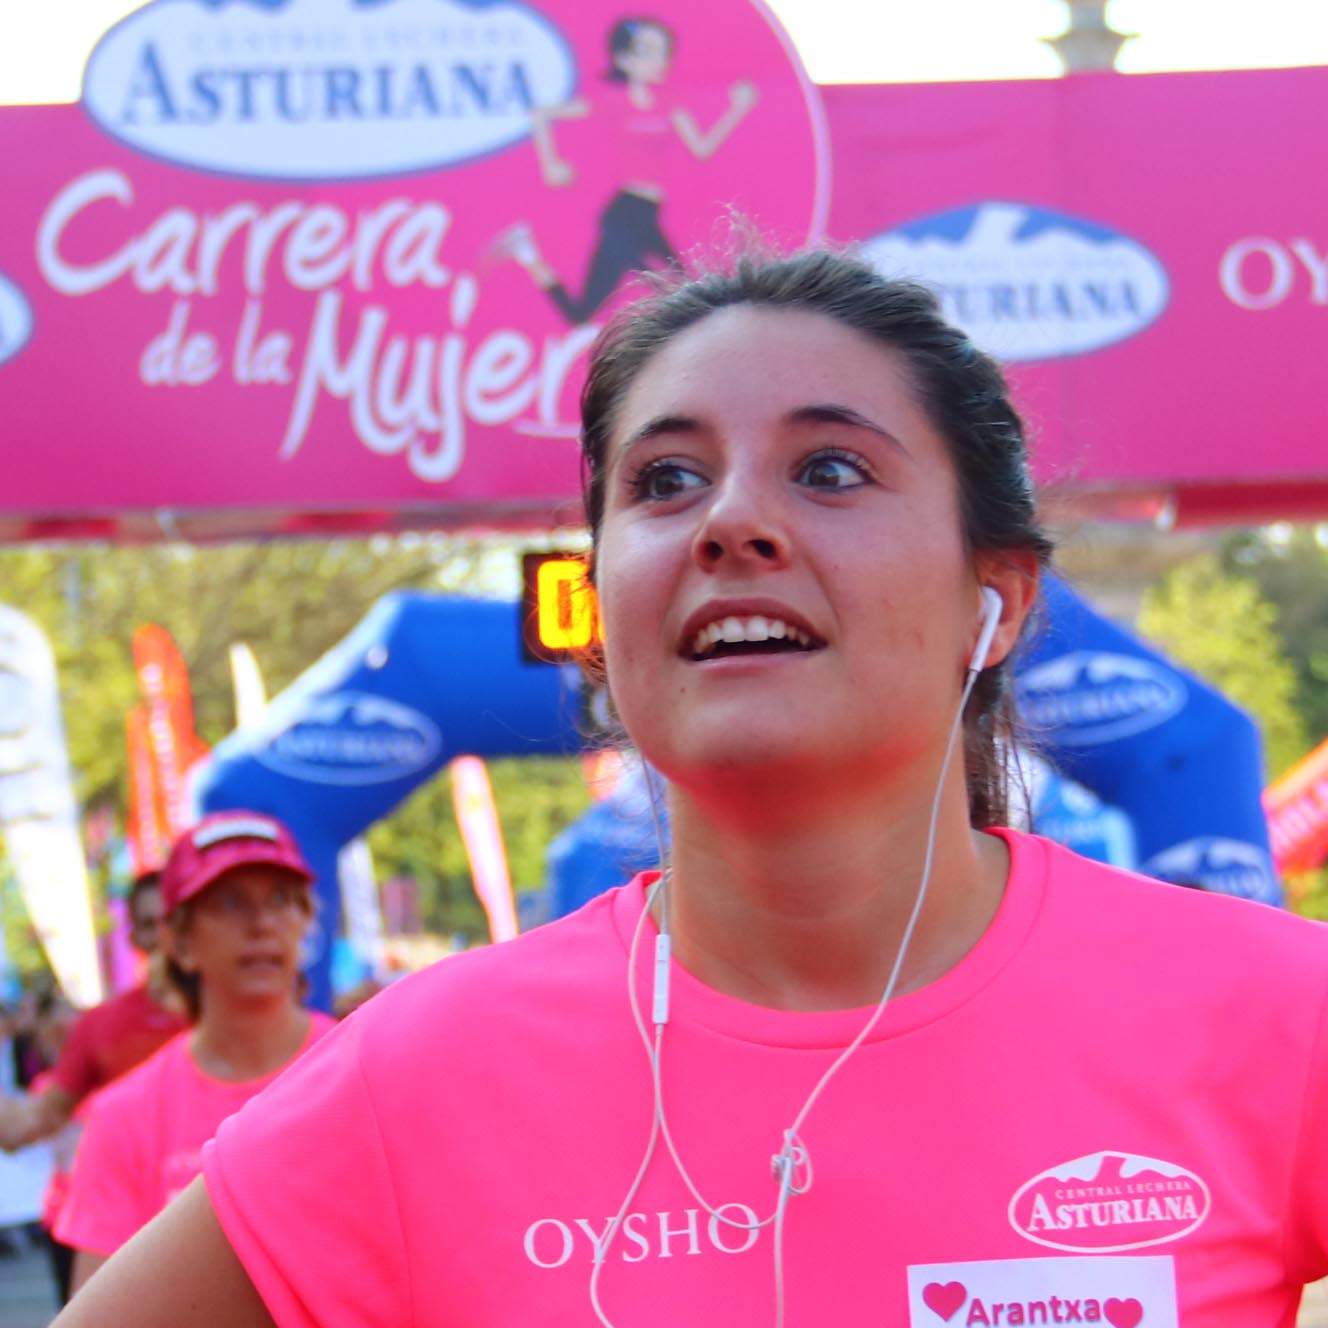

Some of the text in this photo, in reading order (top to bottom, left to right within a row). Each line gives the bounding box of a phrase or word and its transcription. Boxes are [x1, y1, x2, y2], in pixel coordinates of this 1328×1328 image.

[124, 42, 535, 124] ASTURIANA
[36, 168, 451, 296] Carrera
[140, 275, 602, 482] de la Mujer
[1026, 1192, 1199, 1232] ASTURIANA
[1054, 1180, 1193, 1200] CENTRAL LECHERA
[524, 1202, 761, 1269] OYSHO
